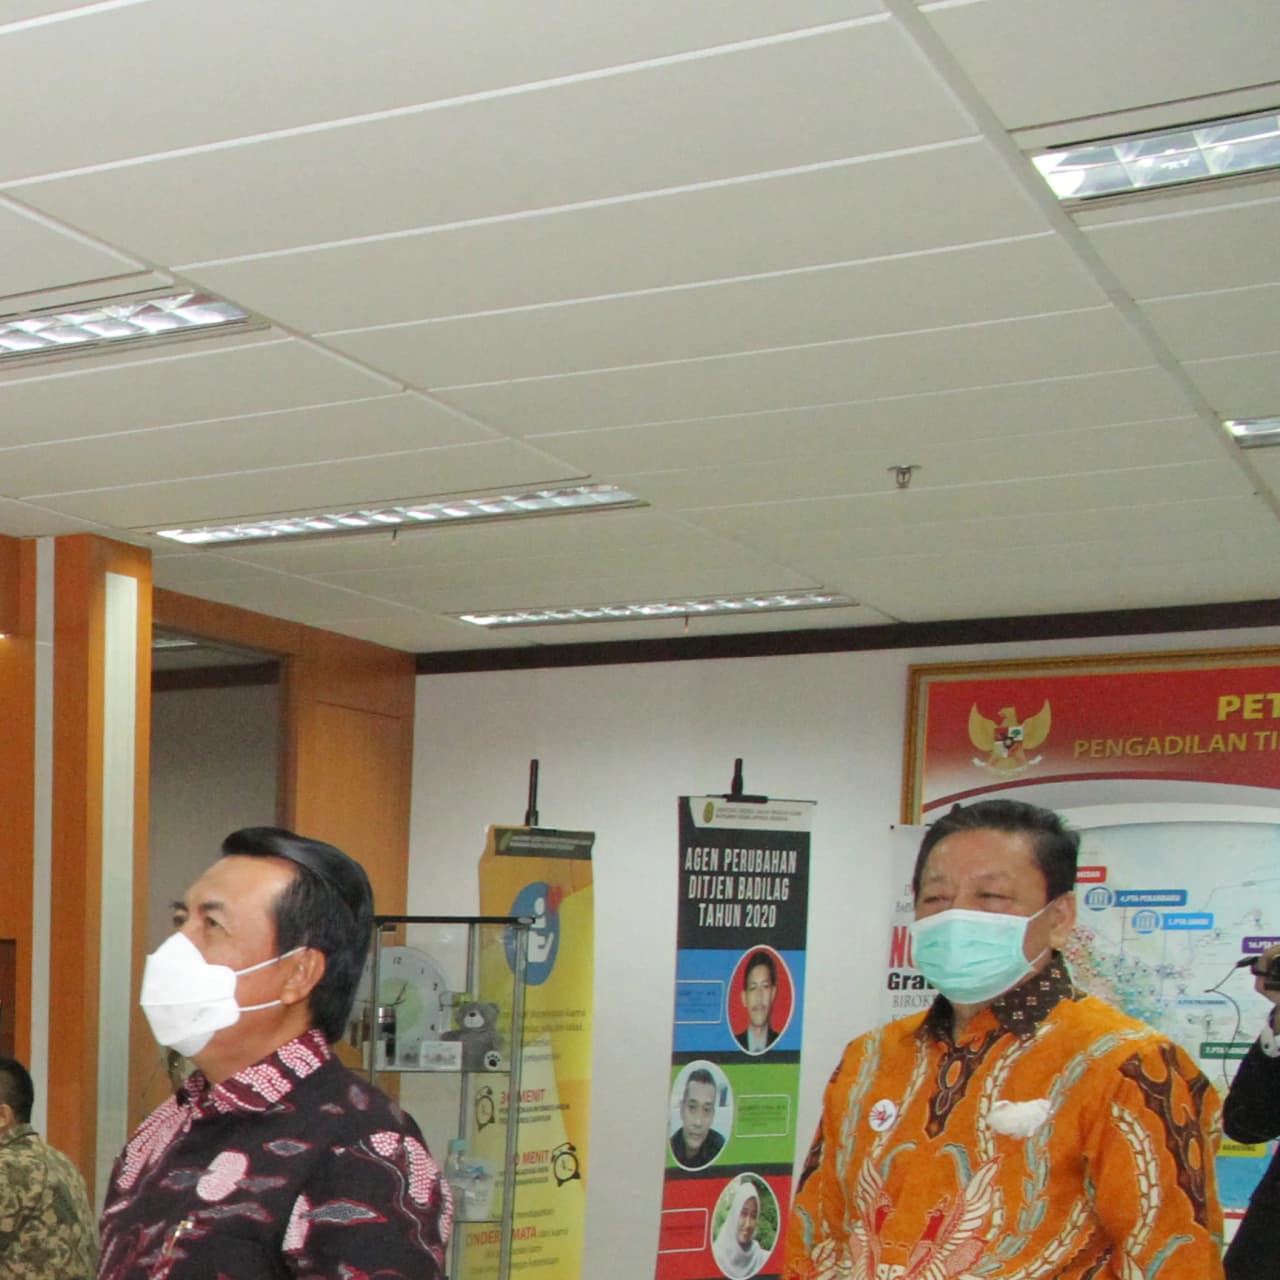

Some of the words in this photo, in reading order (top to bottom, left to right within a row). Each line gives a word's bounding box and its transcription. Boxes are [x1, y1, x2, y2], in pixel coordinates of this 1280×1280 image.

[1074, 732, 1247, 759] PENGADILAN
[685, 848, 719, 872] AGEN
[724, 848, 797, 874] PERUBAHAN
[688, 875, 734, 900] DITJEN
[737, 877, 789, 901] BADILAG
[698, 903, 740, 928] TAHUN
[745, 904, 777, 928] 2020
[887, 971, 936, 990] Gra
